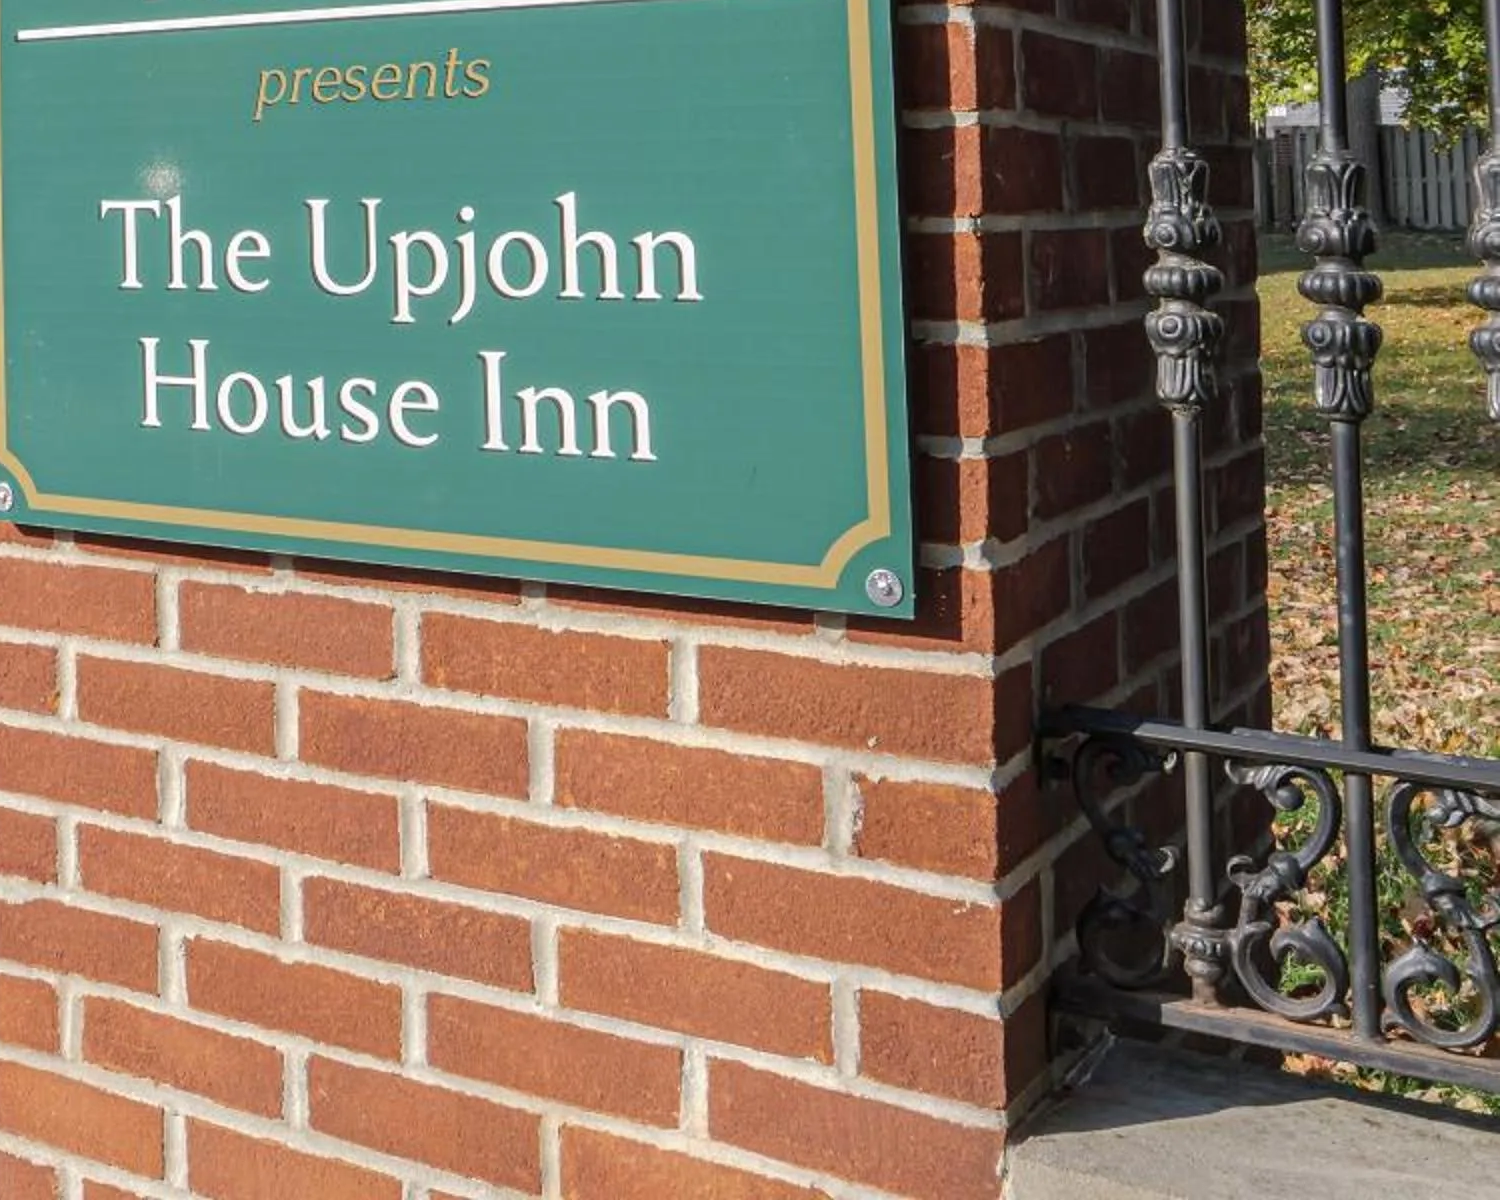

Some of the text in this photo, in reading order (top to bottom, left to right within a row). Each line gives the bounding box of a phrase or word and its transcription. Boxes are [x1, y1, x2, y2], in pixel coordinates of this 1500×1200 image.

[254, 48, 491, 122] presents
[100, 191, 704, 325] The Upjohn
[140, 337, 658, 462] House Inn
